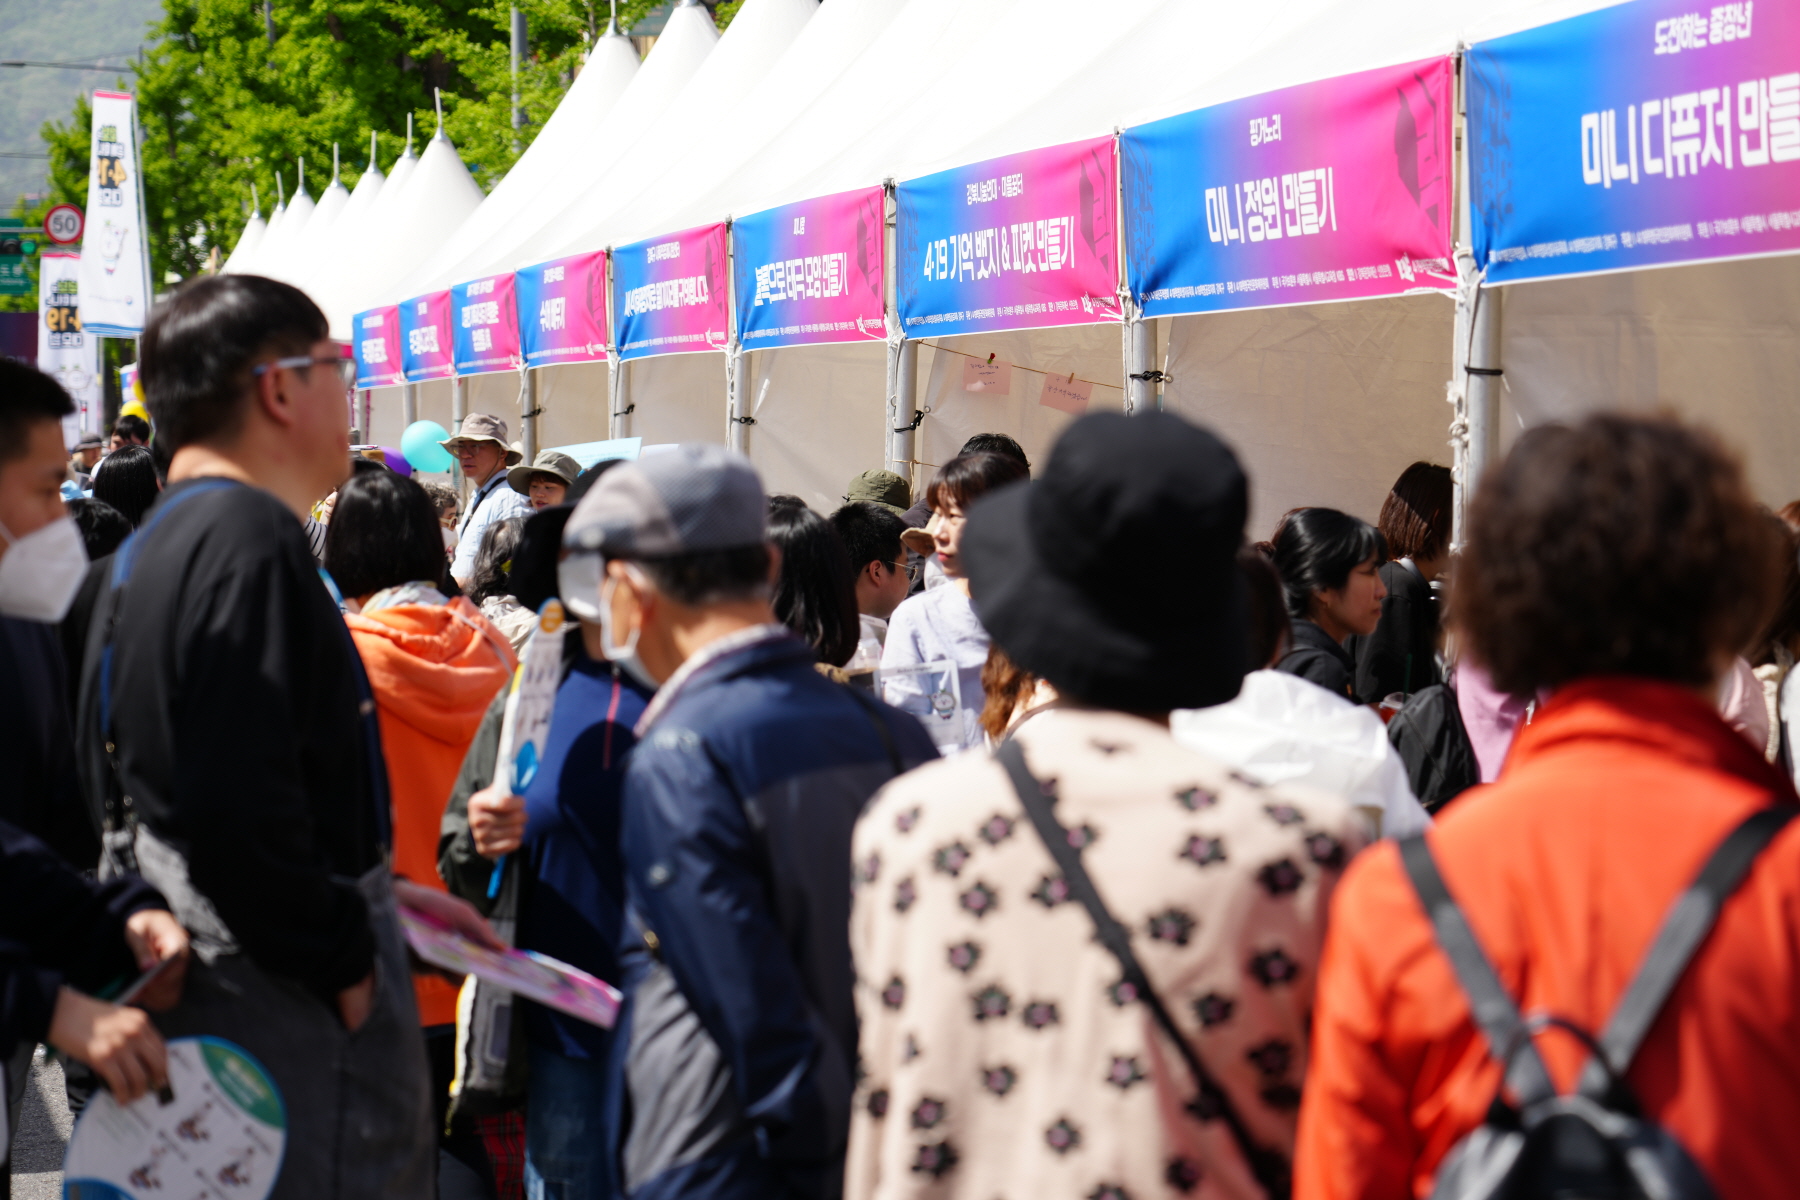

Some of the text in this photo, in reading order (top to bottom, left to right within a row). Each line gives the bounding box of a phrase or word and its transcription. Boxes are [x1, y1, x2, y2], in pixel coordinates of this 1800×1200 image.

[1653, 1, 1754, 56] 도전하는 중장년
[1249, 113, 1282, 147] 핑거노리
[1580, 104, 1639, 190] 미니
[1641, 85, 1734, 180] 디퓨저
[52, 214, 77, 235] 50
[1204, 166, 1338, 247] 미니 정원 만들기
[785, 259, 806, 301] 태극
[805, 255, 823, 299] 모양
[822, 252, 849, 297] 만들기
[923, 238, 948, 282] 4·19
[949, 233, 975, 283] 기억
[1001, 227, 1011, 271] &
[1010, 222, 1037, 275] 피켓
[1037, 215, 1075, 272] 만들기
